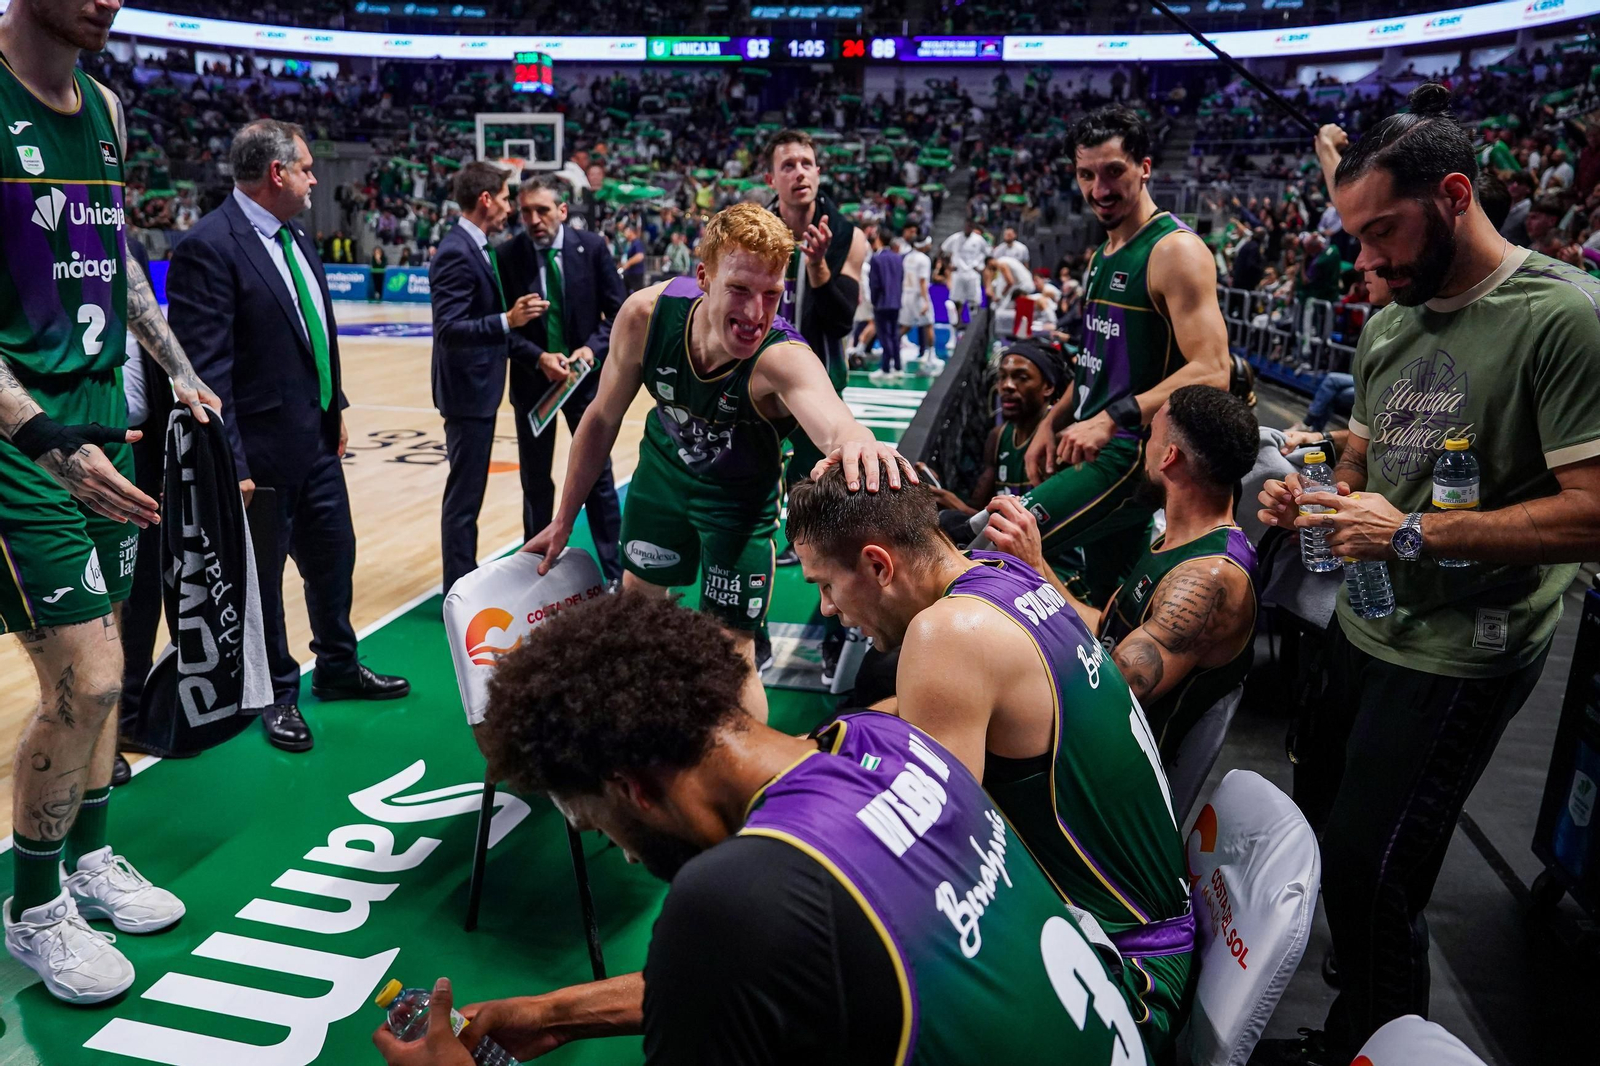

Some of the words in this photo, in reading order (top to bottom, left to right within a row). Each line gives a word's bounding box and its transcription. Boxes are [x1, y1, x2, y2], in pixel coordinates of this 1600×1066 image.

[672, 41, 721, 56] UNICAJA
[788, 40, 825, 57] 1:05
[842, 39, 865, 58] 24
[514, 64, 539, 83] 24
[77, 303, 106, 356] 2
[1385, 378, 1466, 425] Unicaja
[1406, 451, 1429, 463] 1977
[708, 564, 731, 577] sabor
[704, 580, 740, 607] laga
[527, 601, 563, 624] COSTA
[856, 762, 948, 858] WEBB
[1226, 928, 1249, 970] SOL
